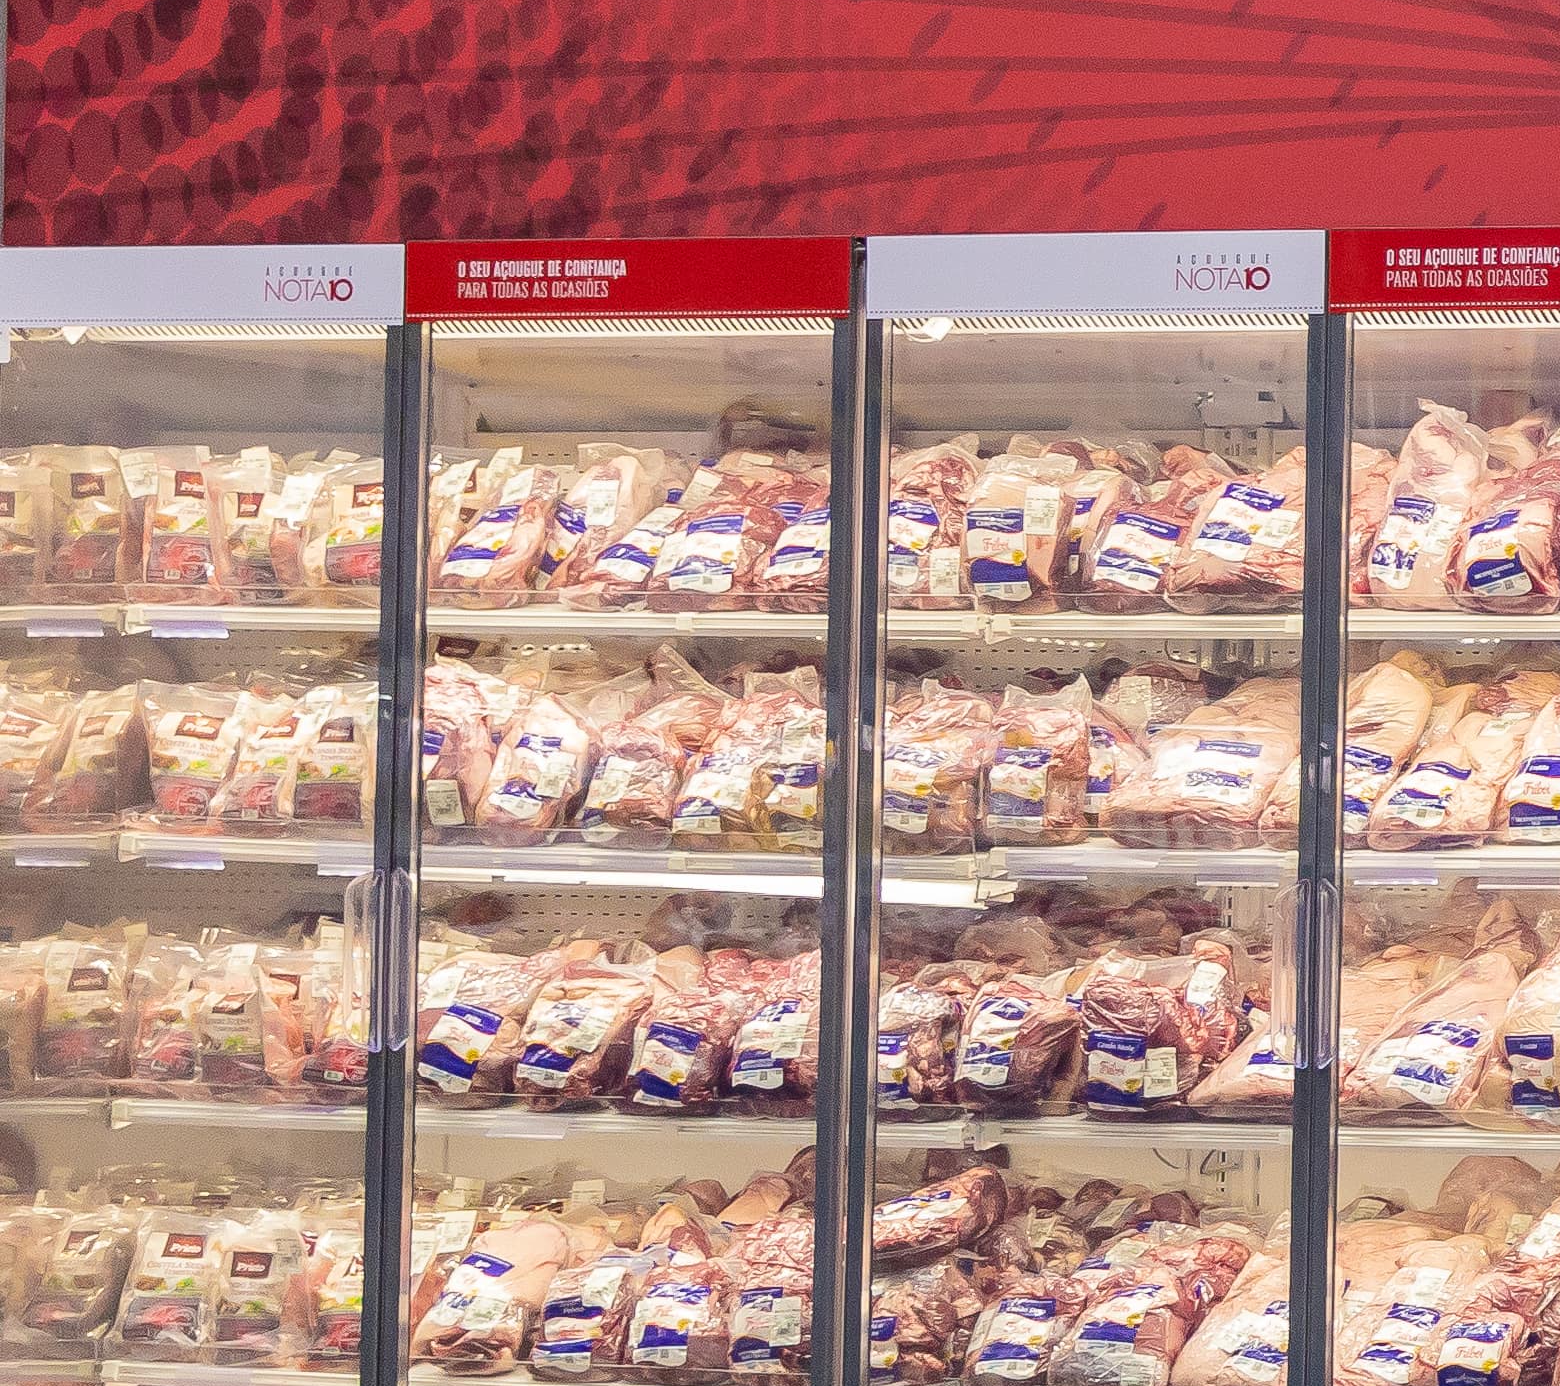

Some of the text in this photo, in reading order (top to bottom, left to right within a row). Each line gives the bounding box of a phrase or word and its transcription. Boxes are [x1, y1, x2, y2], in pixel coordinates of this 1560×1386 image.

[1386, 249, 1394, 266] O
[1400, 249, 1420, 265] SEU
[1425, 248, 1479, 268] AÇOUGUE
[1483, 248, 1497, 264] DE
[458, 259, 627, 280] O SEU AÇOUGUE DE CONFIANÇA
[1175, 266, 1270, 291] NOTA10
[1386, 267, 1548, 288] PARA TODAS AS OCASIÕES
[265, 278, 353, 302] NOTA10
[458, 278, 609, 299] PARA TODAS AS OCASIÕES
